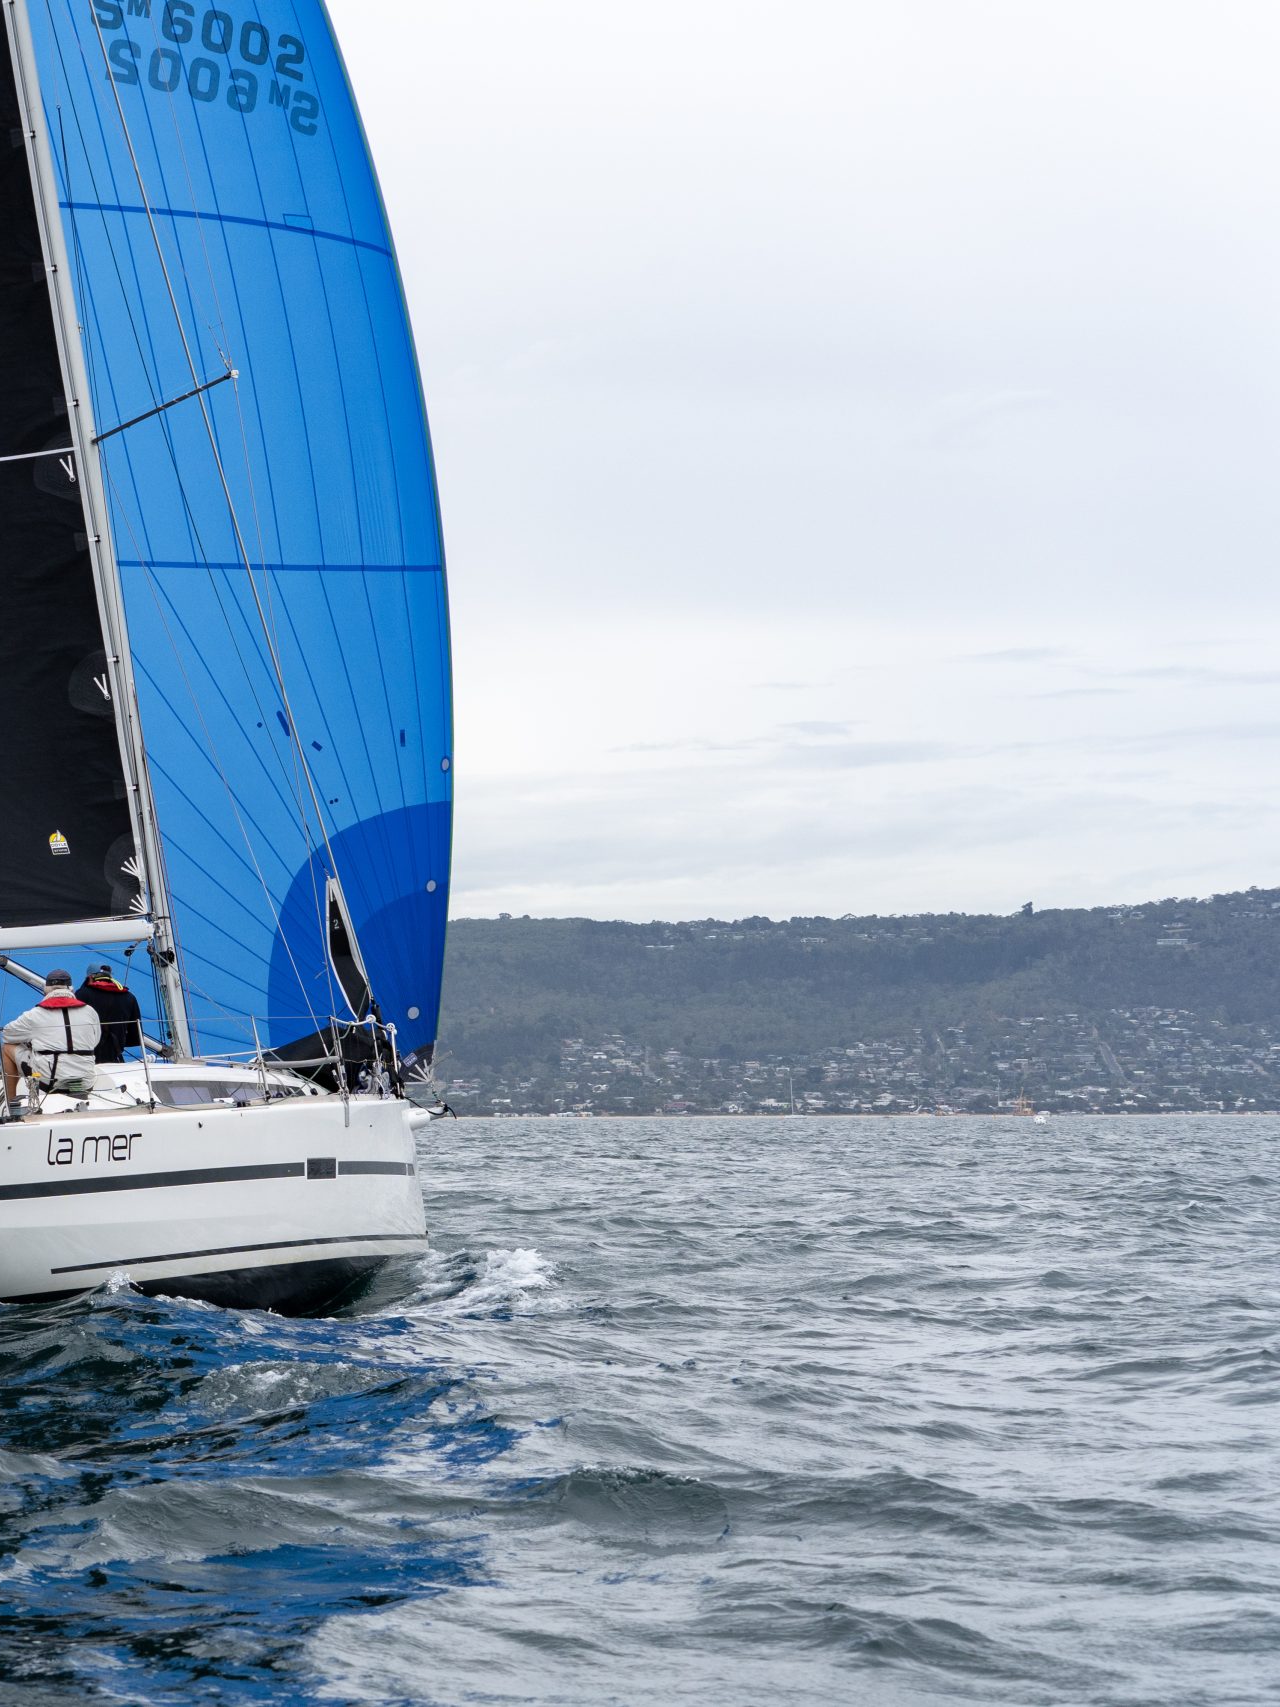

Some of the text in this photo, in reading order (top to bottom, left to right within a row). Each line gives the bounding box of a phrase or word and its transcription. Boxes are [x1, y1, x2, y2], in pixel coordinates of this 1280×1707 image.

[333, 919, 340, 930] 2
[47, 1129, 142, 1166] la mer
